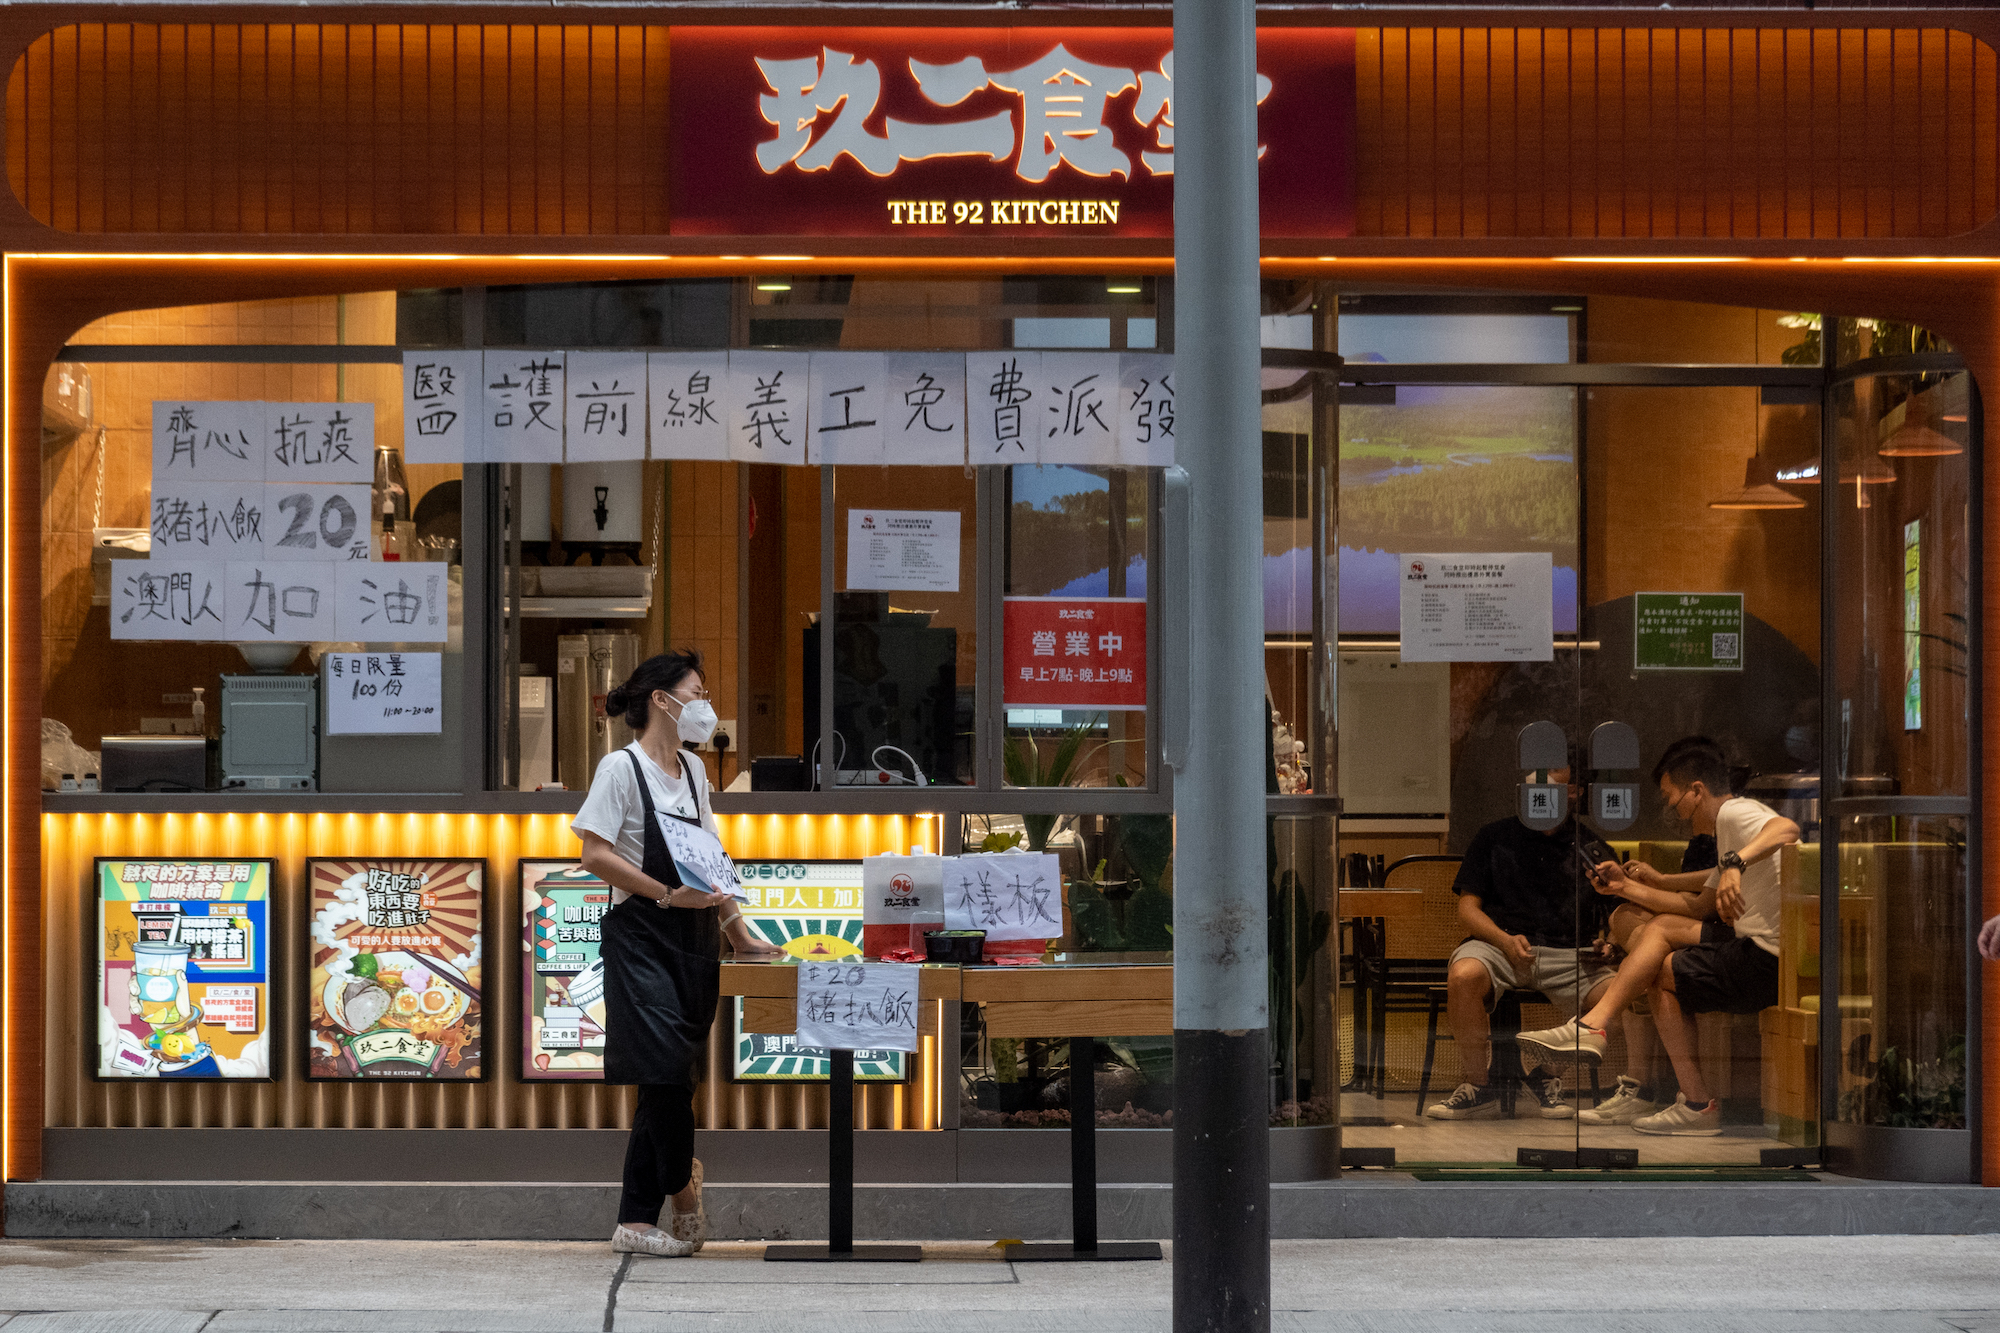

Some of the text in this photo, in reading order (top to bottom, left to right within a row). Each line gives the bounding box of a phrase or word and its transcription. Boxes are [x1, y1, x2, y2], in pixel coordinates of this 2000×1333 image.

[887, 201, 1120, 225] THE 92 KITCHEN
[1032, 630, 1122, 657] 營業中
[1020, 667, 1133, 683] 早上7點-晚上9點
[1533, 793, 1546, 807] 推
[1606, 793, 1620, 807] 推
[366, 868, 421, 893] 好吃的
[367, 892, 421, 911] 東西要
[140, 921, 173, 929] LEMON
[368, 909, 431, 928] 吃進肚子
[147, 931, 167, 940] TEA
